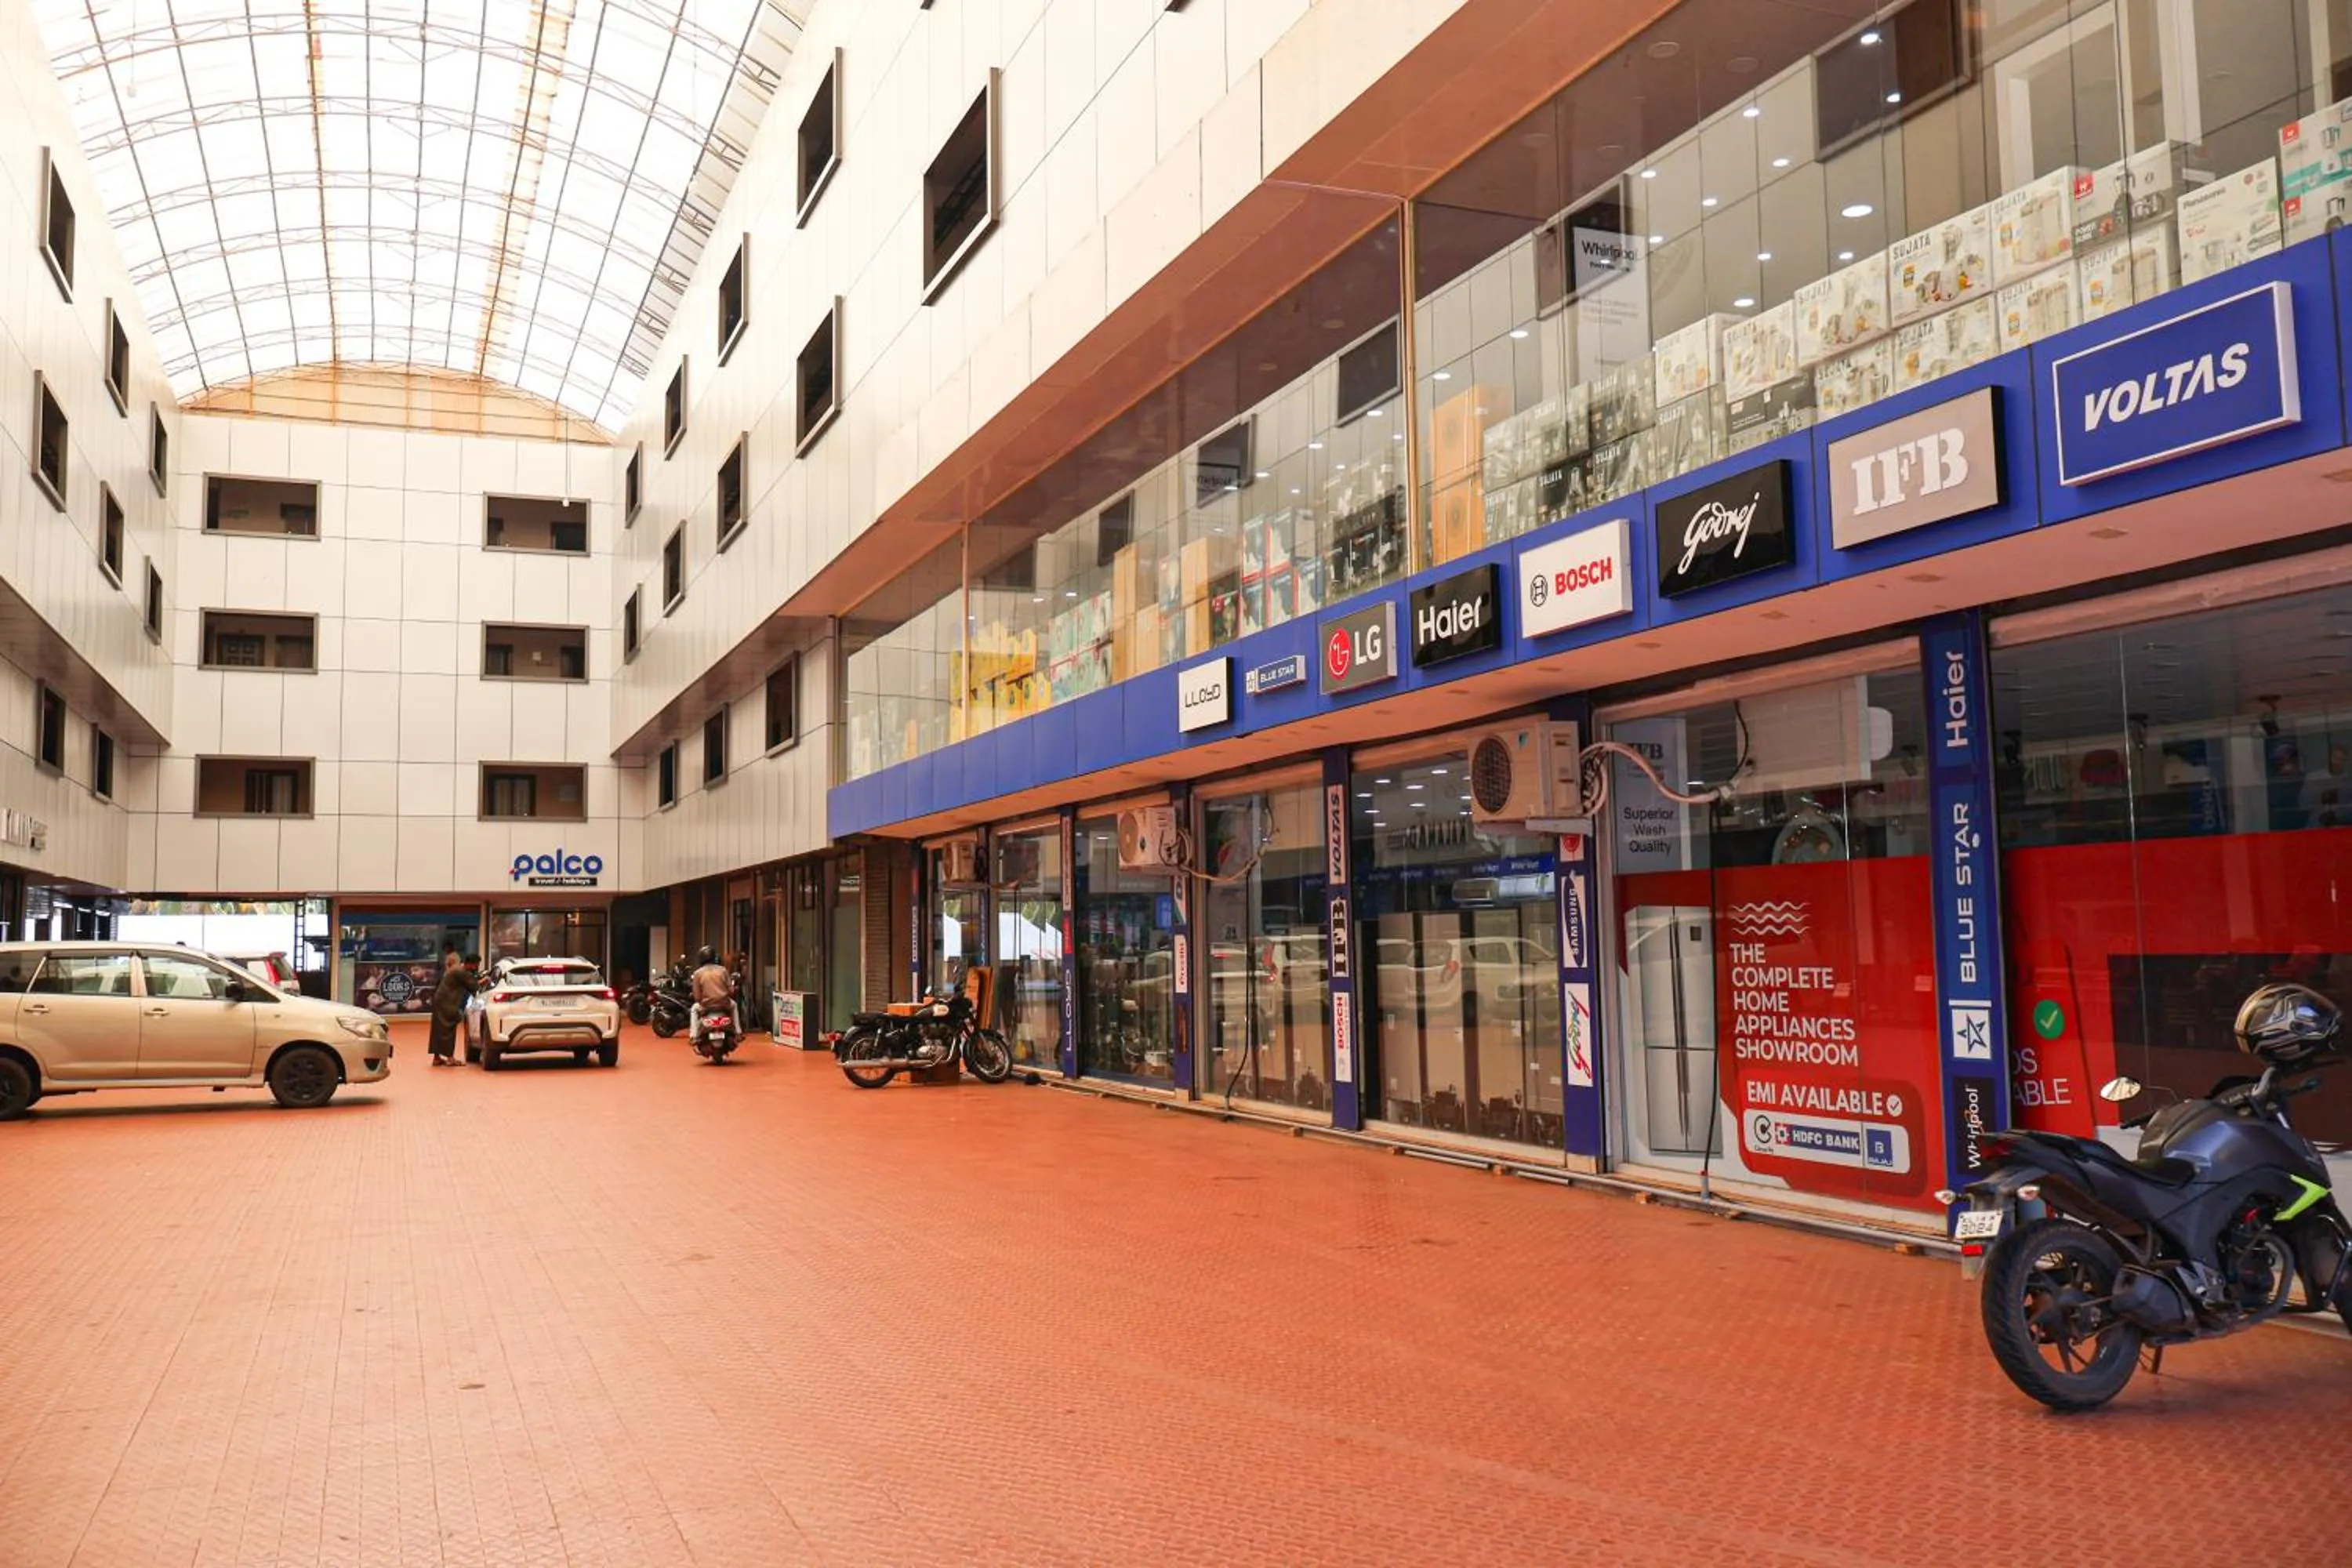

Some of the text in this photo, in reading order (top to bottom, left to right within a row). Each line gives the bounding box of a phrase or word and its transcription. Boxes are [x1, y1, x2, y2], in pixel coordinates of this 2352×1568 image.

[1893, 234, 1931, 260] SUJATA
[2002, 280, 2033, 303] SUJATA
[2083, 343, 2250, 432] VOLTAS
[1851, 426, 1969, 517] IFB
[1678, 491, 1760, 575] Godrej
[1554, 556, 1613, 596] BOSCH
[1417, 594, 1483, 645] Haier
[1354, 624, 1381, 666] LG
[1260, 669, 1277, 683] BLUE
[1943, 650, 1969, 748] Haier
[1623, 806, 1675, 822] Superior
[1332, 793, 1343, 877] VOLTAS
[1632, 824, 1667, 837] Wash
[1628, 840, 1672, 856] Quality
[514, 848, 603, 882] palco
[1953, 802, 1976, 984] BLUE STAR
[1569, 887, 1581, 956] SAMSUNG
[1730, 943, 1766, 964] THE
[1732, 967, 1835, 989] COMPLETE
[1733, 991, 1790, 1013] HOME
[1734, 1014, 1857, 1041] APPLIANCES
[1735, 1038, 1859, 1067] SHOWROOM
[1747, 1080, 1883, 1116] EMI AVAILABLE
[1793, 1130, 1860, 1149] HDFC BANK
